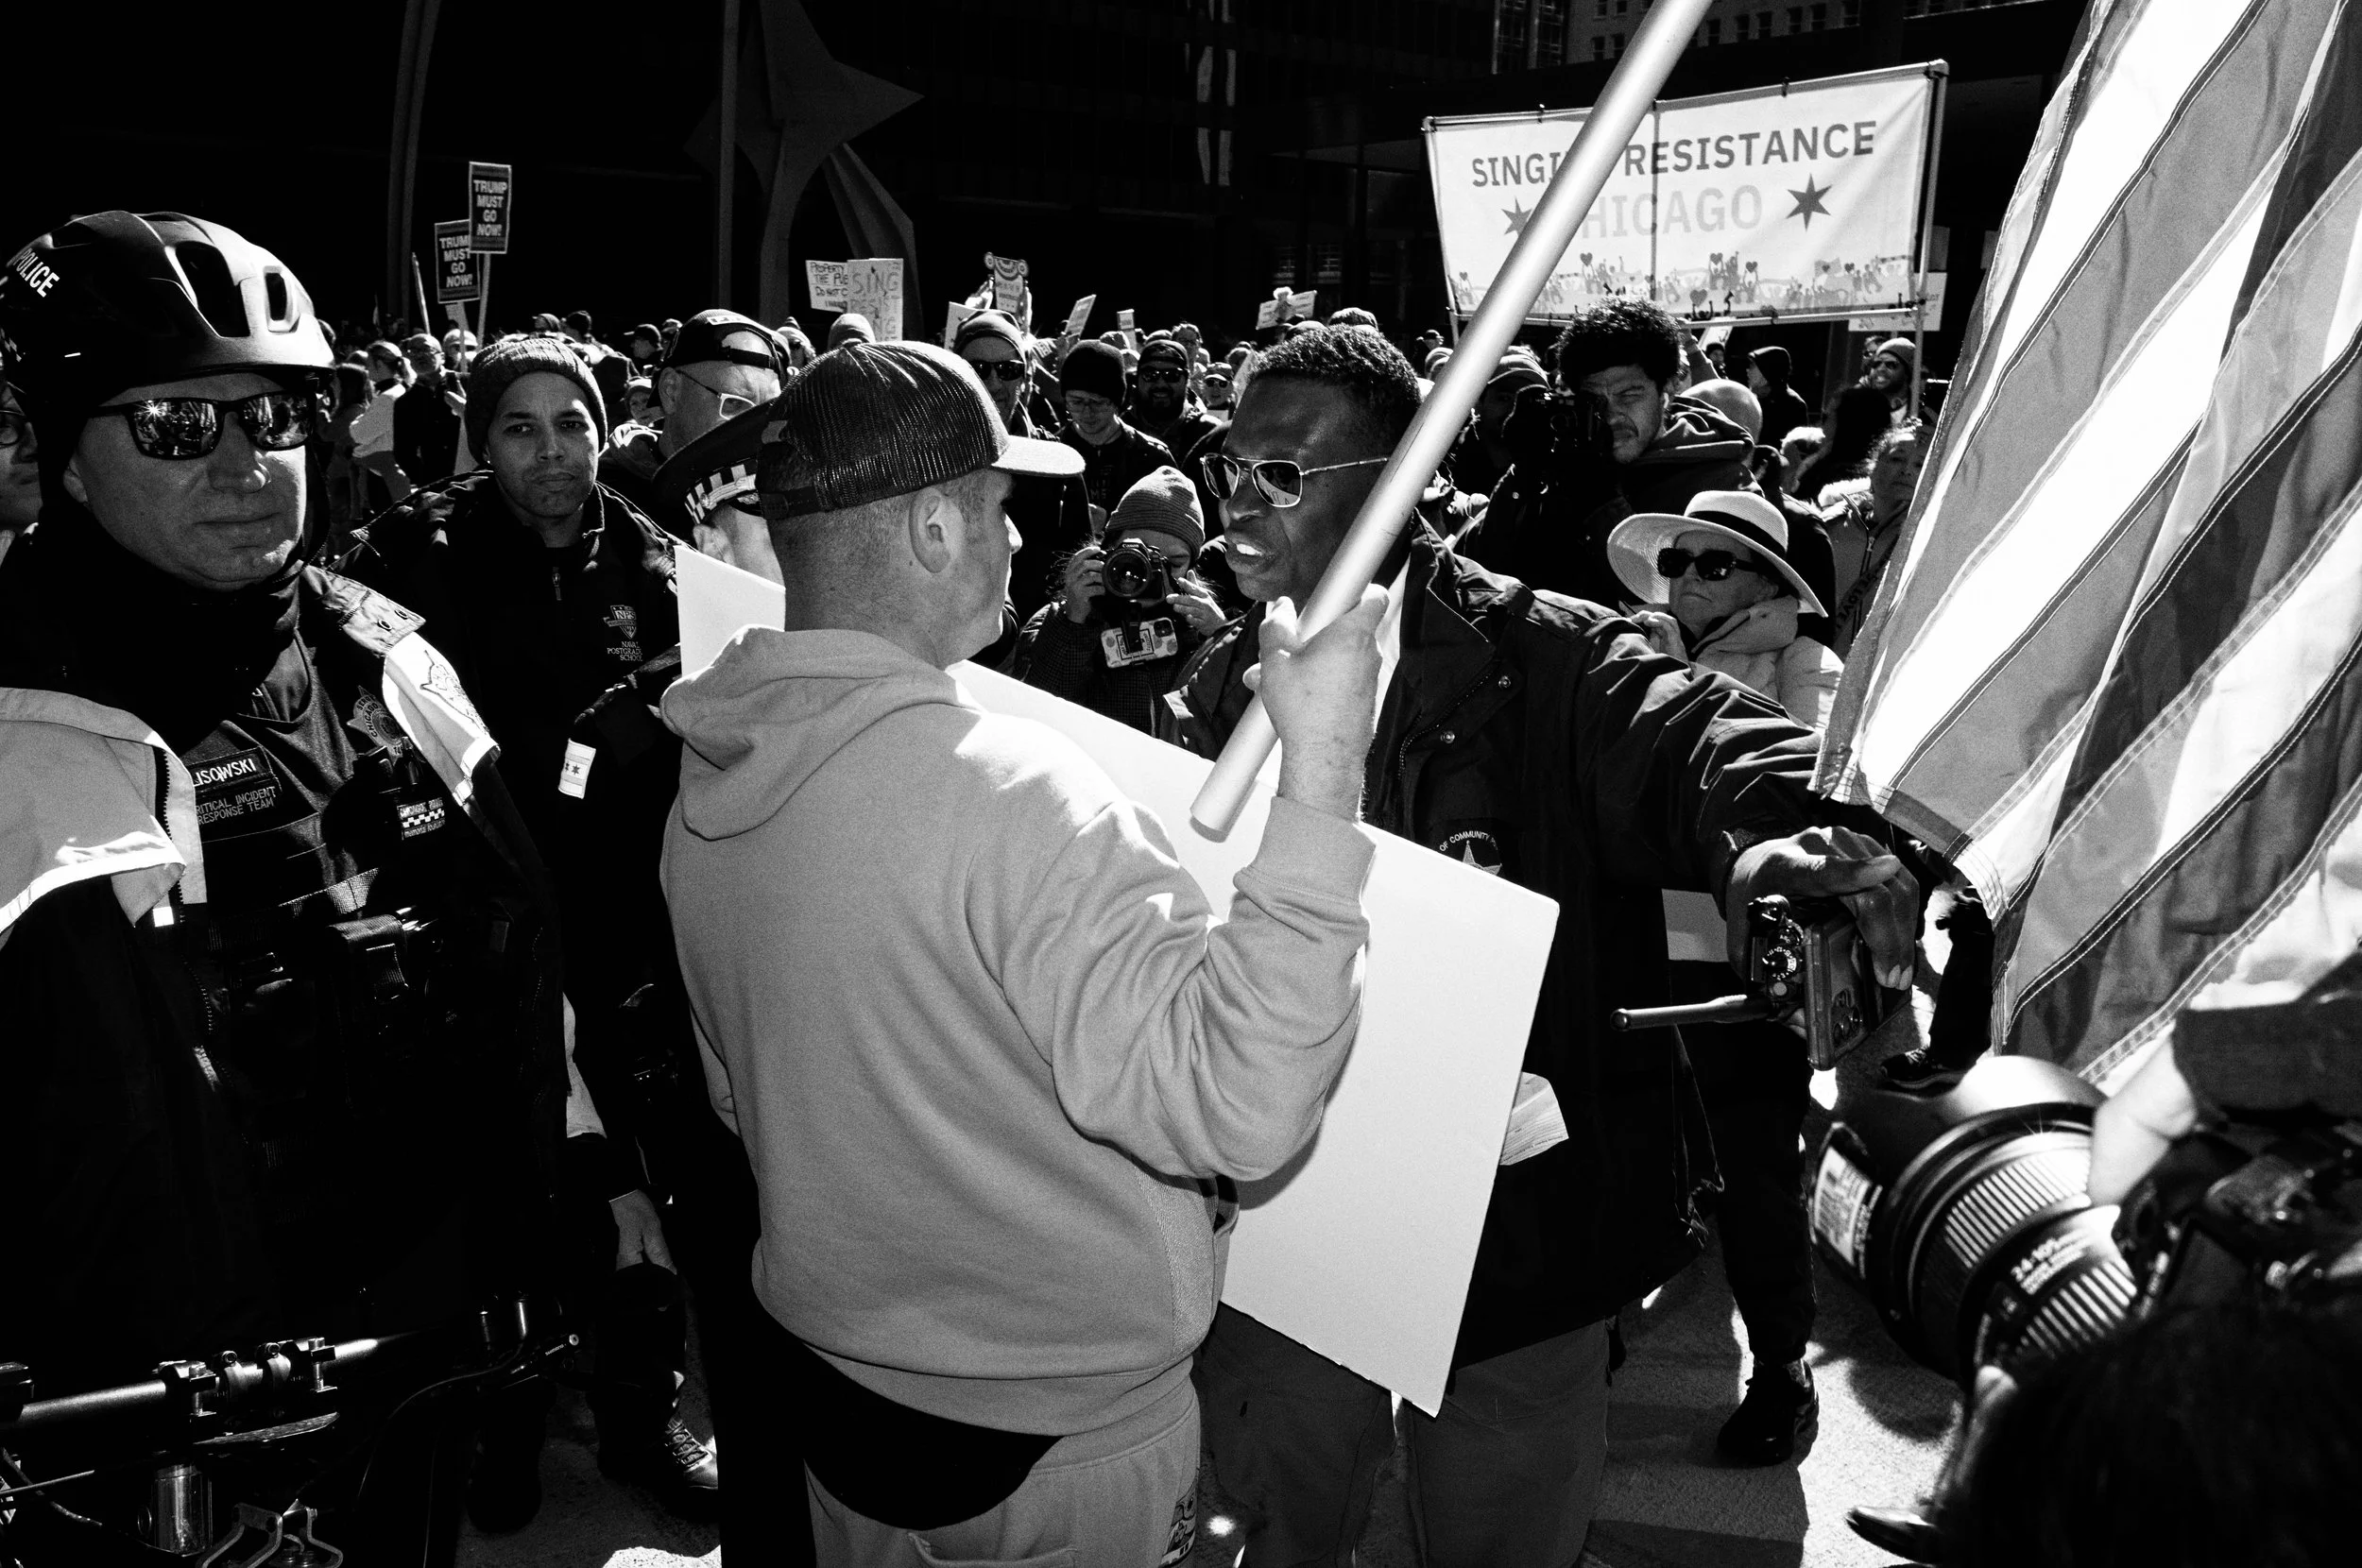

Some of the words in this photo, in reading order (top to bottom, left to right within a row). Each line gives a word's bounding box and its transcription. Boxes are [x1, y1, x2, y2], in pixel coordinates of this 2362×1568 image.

[1472, 150, 1569, 187] SINGI
[1624, 120, 1876, 177] RESISTANCE
[473, 179, 508, 195] TRUMP
[476, 195, 504, 208] MUST
[1582, 184, 1762, 239] HICAGO
[483, 209, 498, 222] GO
[439, 234, 471, 248] TRUM
[444, 247, 471, 262] MUST
[12, 247, 60, 298] POLICE
[451, 261, 466, 274] GO
[852, 271, 899, 294] SING
[364, 702, 379, 738] CHICAGO
[193, 758, 256, 788] ISOWSKI
[196, 797, 232, 816] RITICAL
[234, 786, 277, 806] INCIDENT
[197, 804, 245, 827] RESPONSE
[247, 796, 275, 812] TEAM
[1439, 840, 1449, 851] OF
[1448, 830, 1491, 844] COMMUNITY
